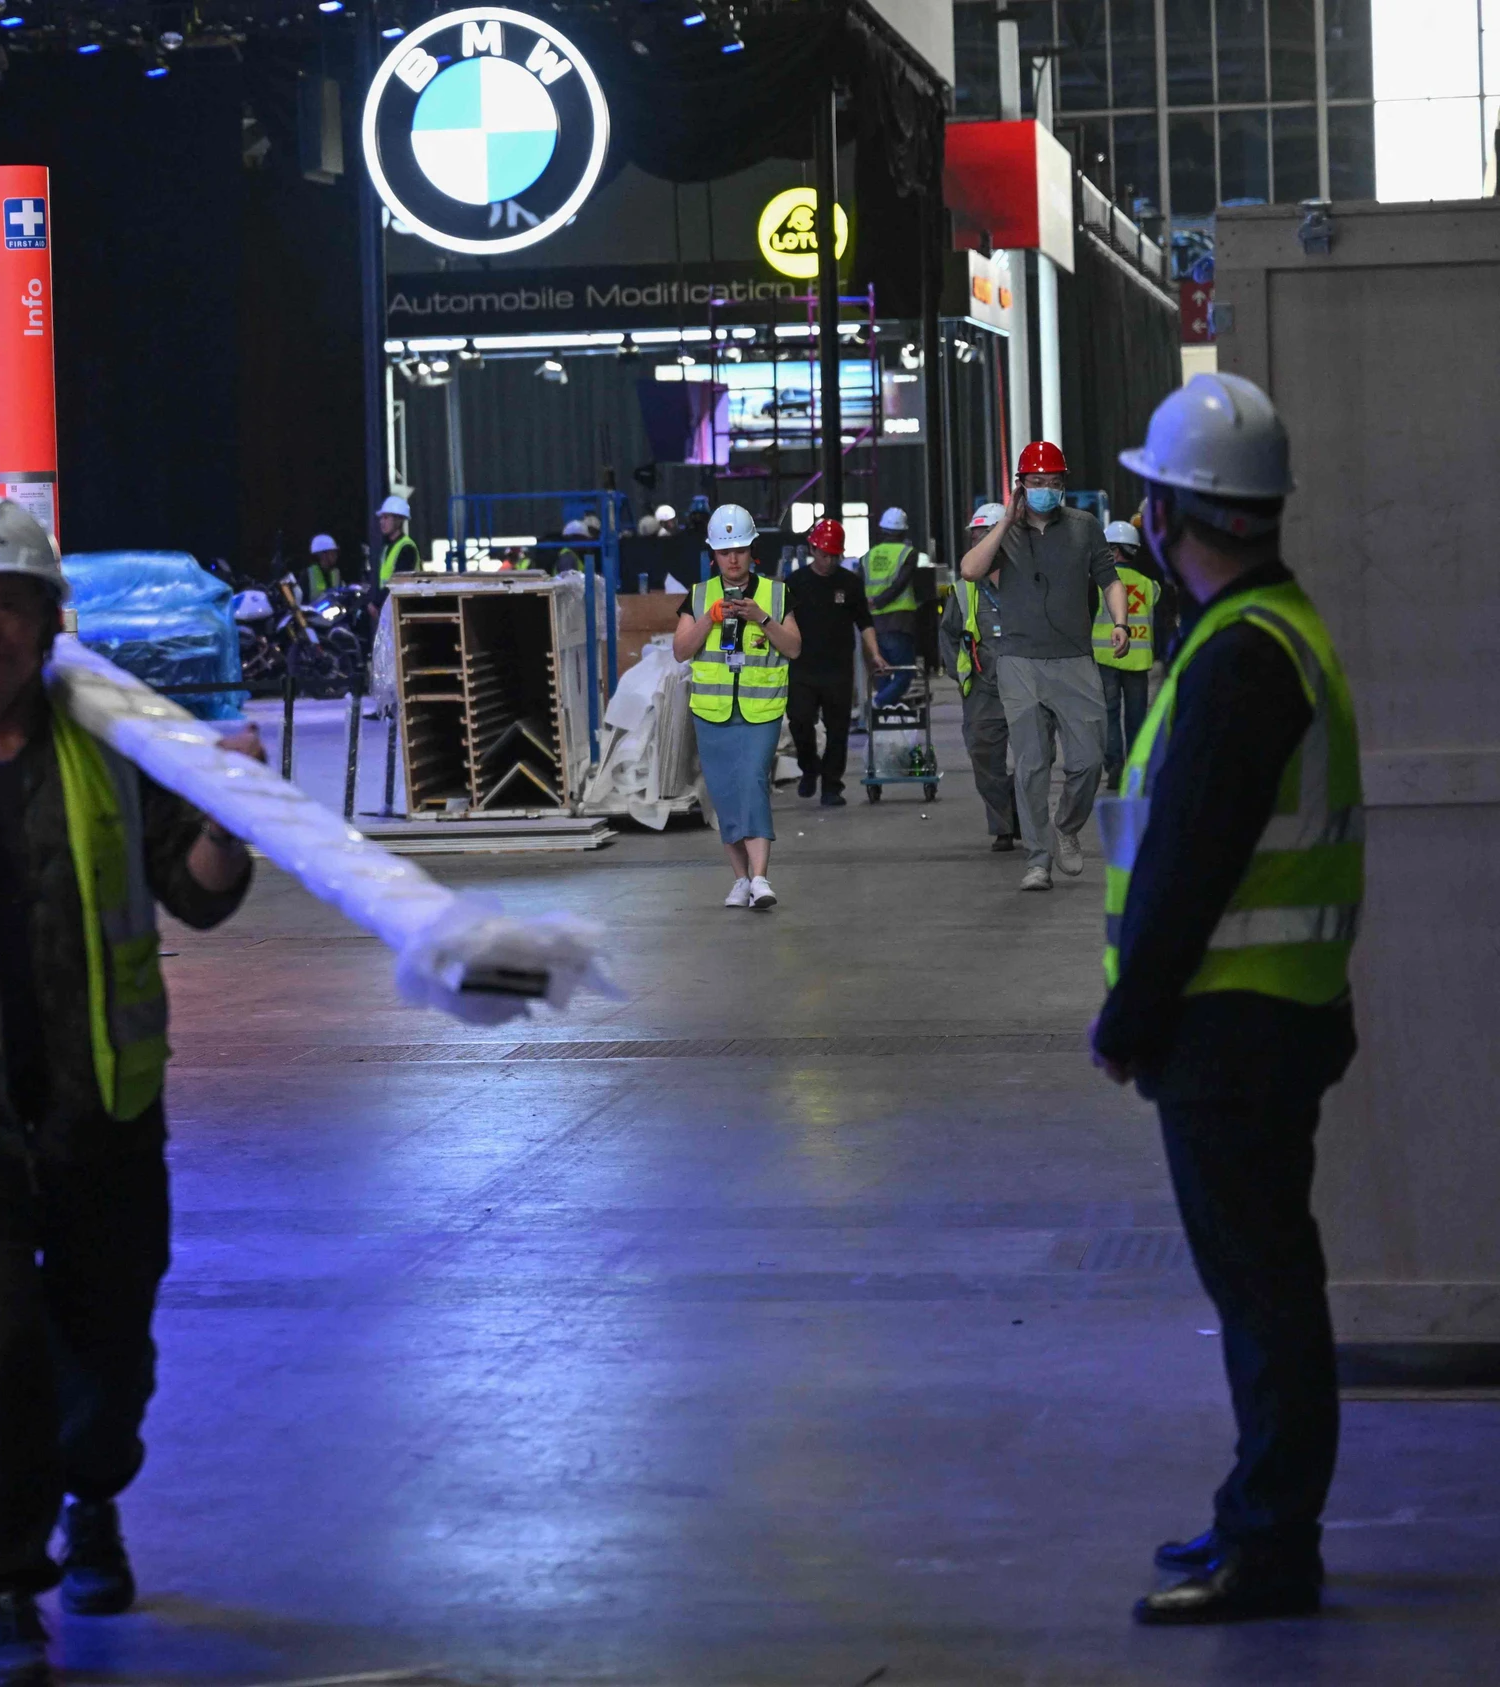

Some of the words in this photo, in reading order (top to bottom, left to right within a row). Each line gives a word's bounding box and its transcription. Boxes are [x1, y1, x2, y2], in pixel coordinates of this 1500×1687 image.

[395, 21, 572, 92] BMW
[9, 240, 32, 248] FIRST
[772, 231, 819, 251] LOTU
[21, 278, 44, 336] Info
[387, 287, 574, 315] Automobile
[586, 279, 795, 307] Modification
